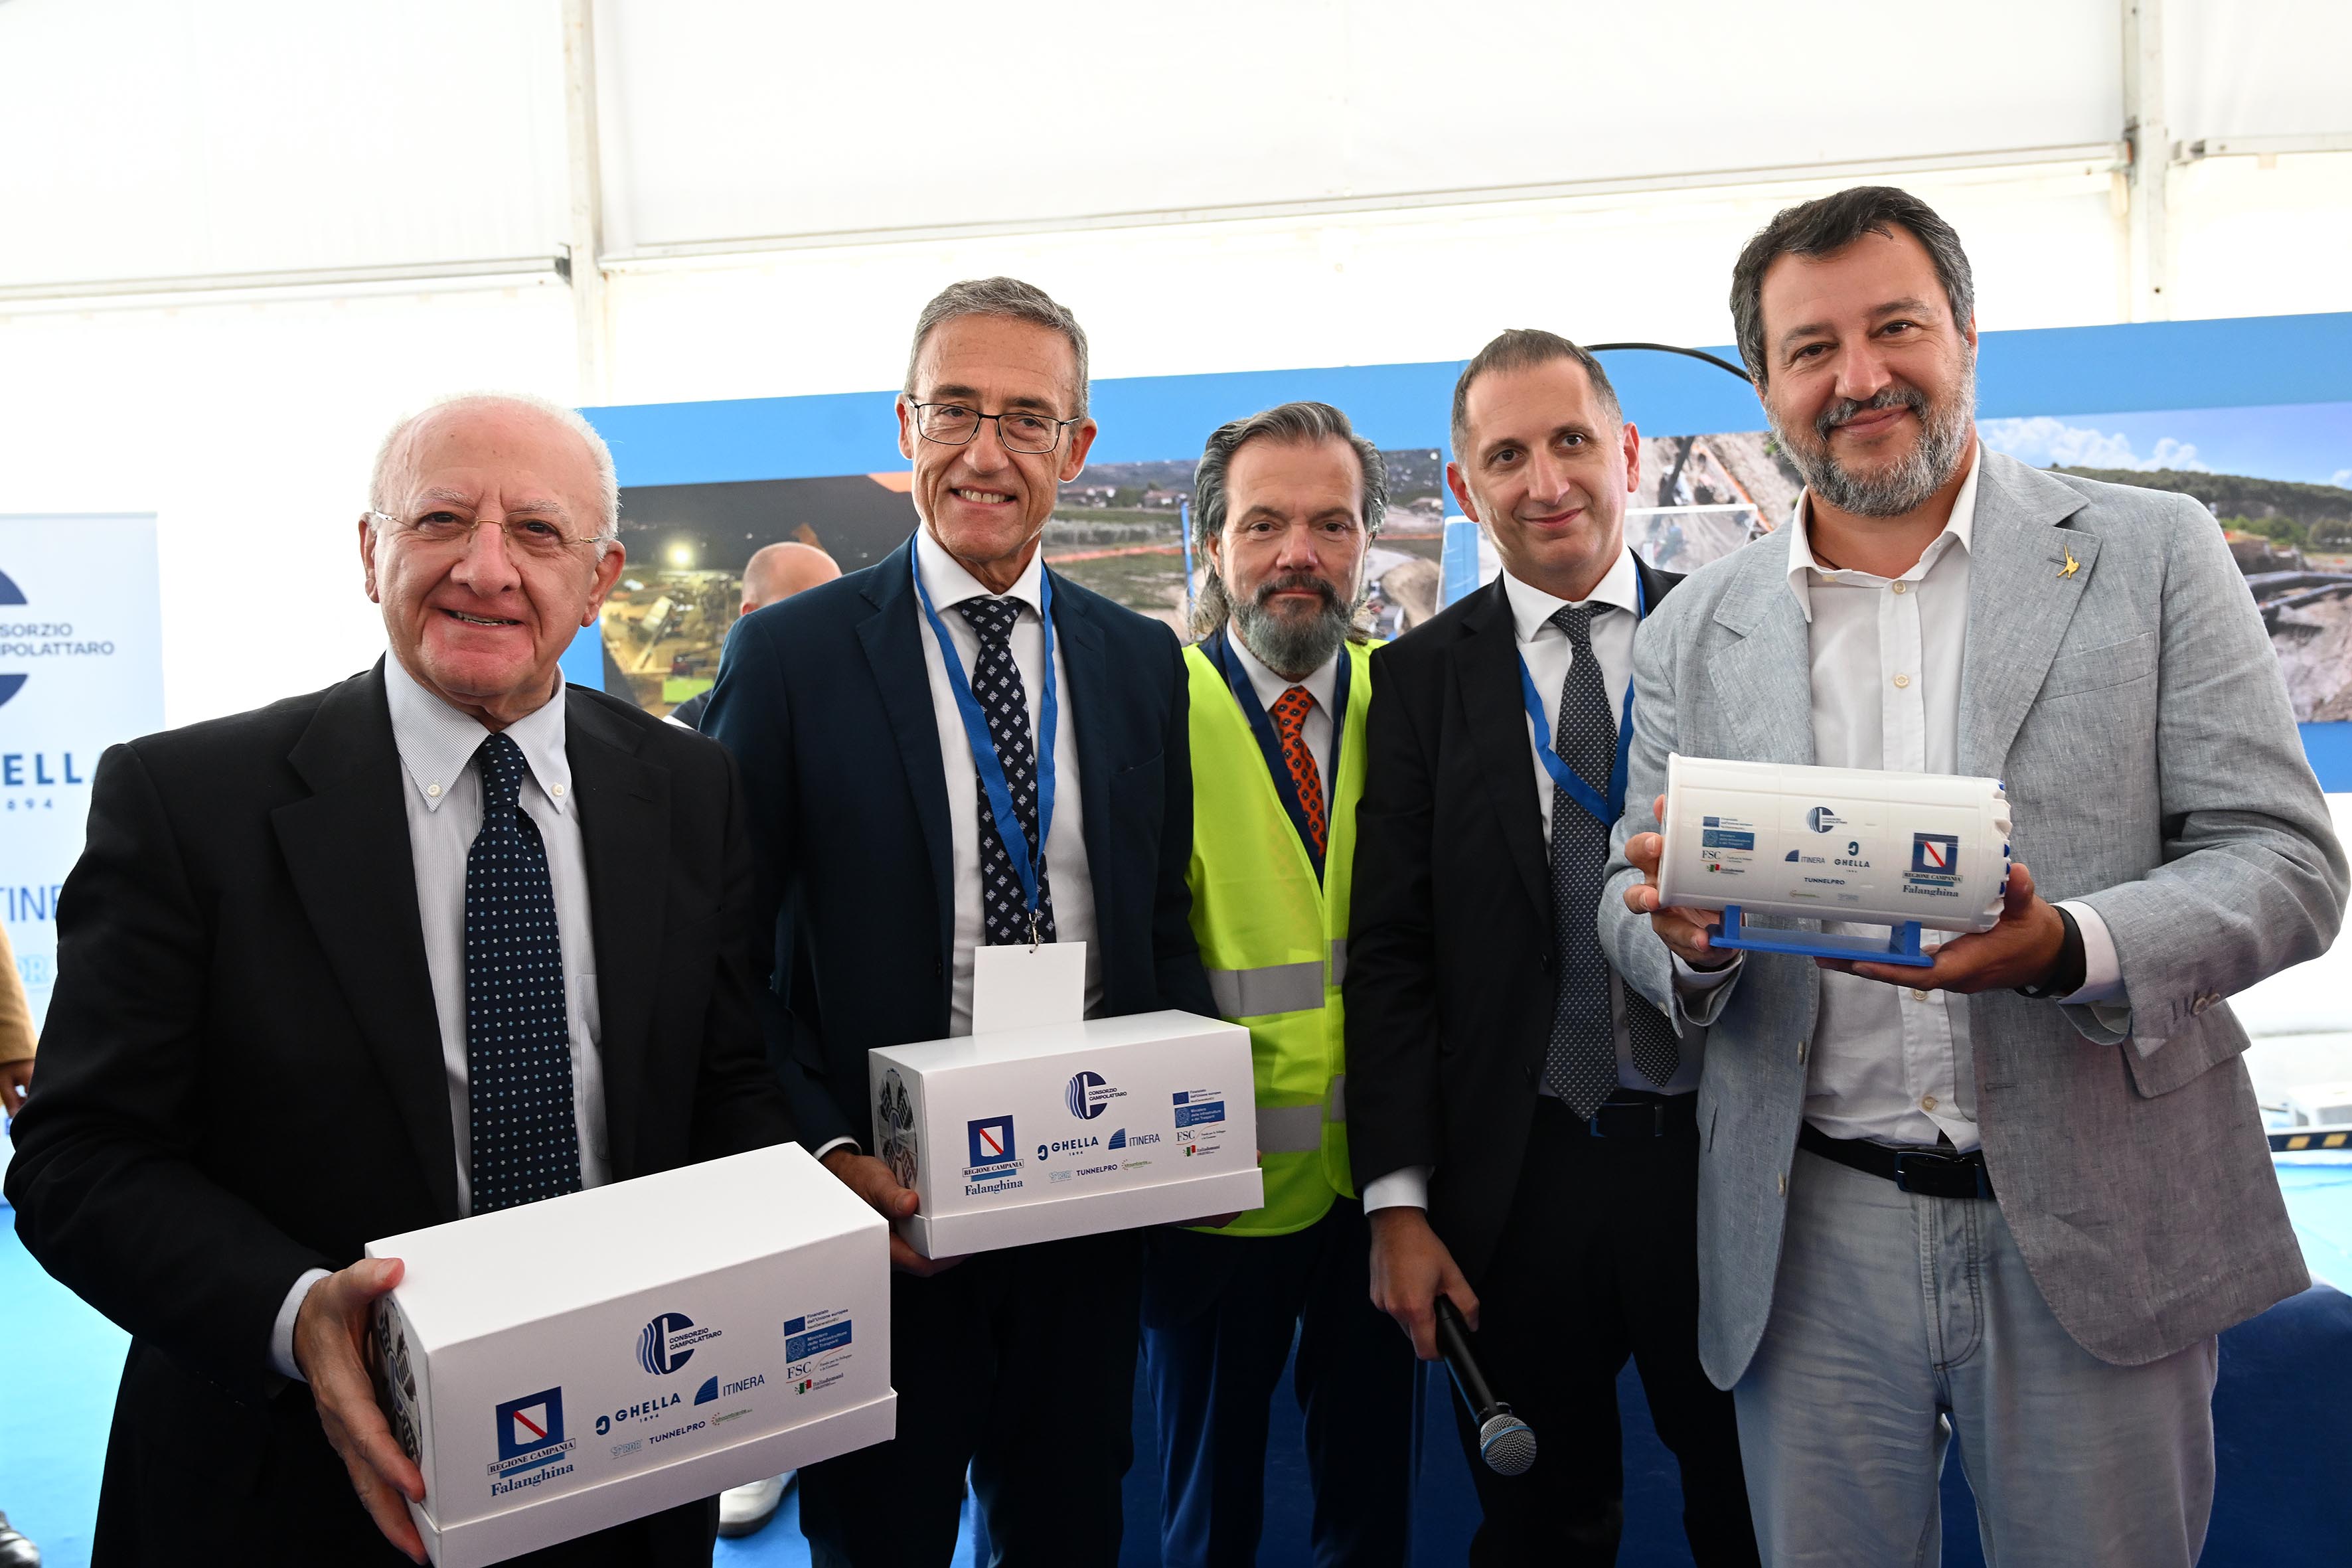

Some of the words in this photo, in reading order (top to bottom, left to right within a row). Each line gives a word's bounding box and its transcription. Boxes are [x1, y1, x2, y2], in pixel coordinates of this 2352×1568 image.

[0, 641, 115, 656] POLATTARO
[1702, 850, 1721, 860] FSC
[1834, 859, 1870, 868] GHELLA
[1903, 885, 1958, 897] Falanghina
[1089, 1087, 1117, 1096] CONSORZIO
[1089, 1091, 1127, 1101] CAMPOLATTARO
[1129, 1133, 1160, 1146] ITINERA
[1176, 1130, 1195, 1141] FSC
[1052, 1137, 1099, 1152] GHELLA
[964, 1166, 990, 1176] REGIONE
[992, 1161, 1022, 1171] CAMPANIA
[1076, 1164, 1117, 1176] TUNNELPRO
[965, 1180, 1023, 1196] Falanghina
[669, 1328, 708, 1344] CONSORZIO
[670, 1330, 722, 1350] CAMPOLATTARO
[787, 1362, 811, 1379] FSC
[723, 1374, 765, 1397] ITINERA
[615, 1393, 680, 1421] GHELLA
[640, 1413, 659, 1423] 1894
[649, 1421, 706, 1445] TUNNELPRO
[490, 1455, 528, 1473] REGIONE
[530, 1442, 574, 1460] CAMPANIA
[491, 1464, 574, 1496] Falanghina
